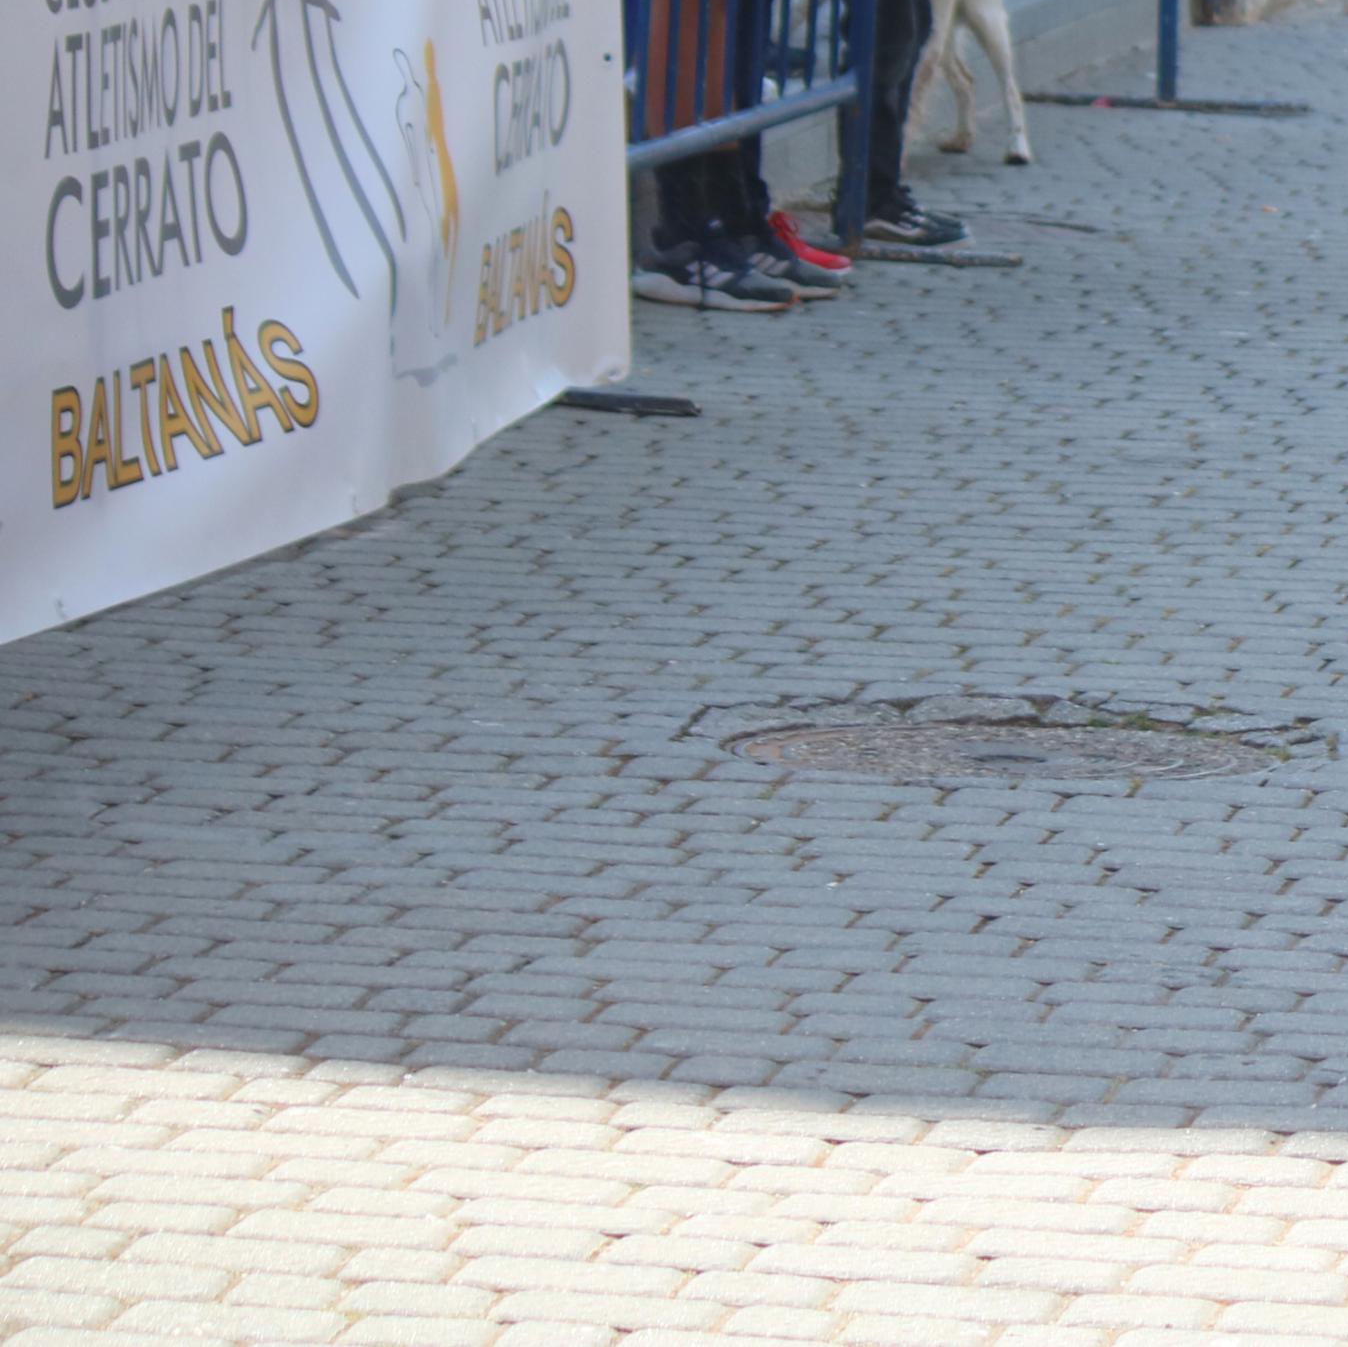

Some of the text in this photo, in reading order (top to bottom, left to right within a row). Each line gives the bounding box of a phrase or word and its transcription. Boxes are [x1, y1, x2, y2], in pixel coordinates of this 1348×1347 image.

[46, 7, 179, 159] ATLETISMO
[46, 131, 248, 309] CERRATO
[52, 306, 319, 509] BALTANÁS
